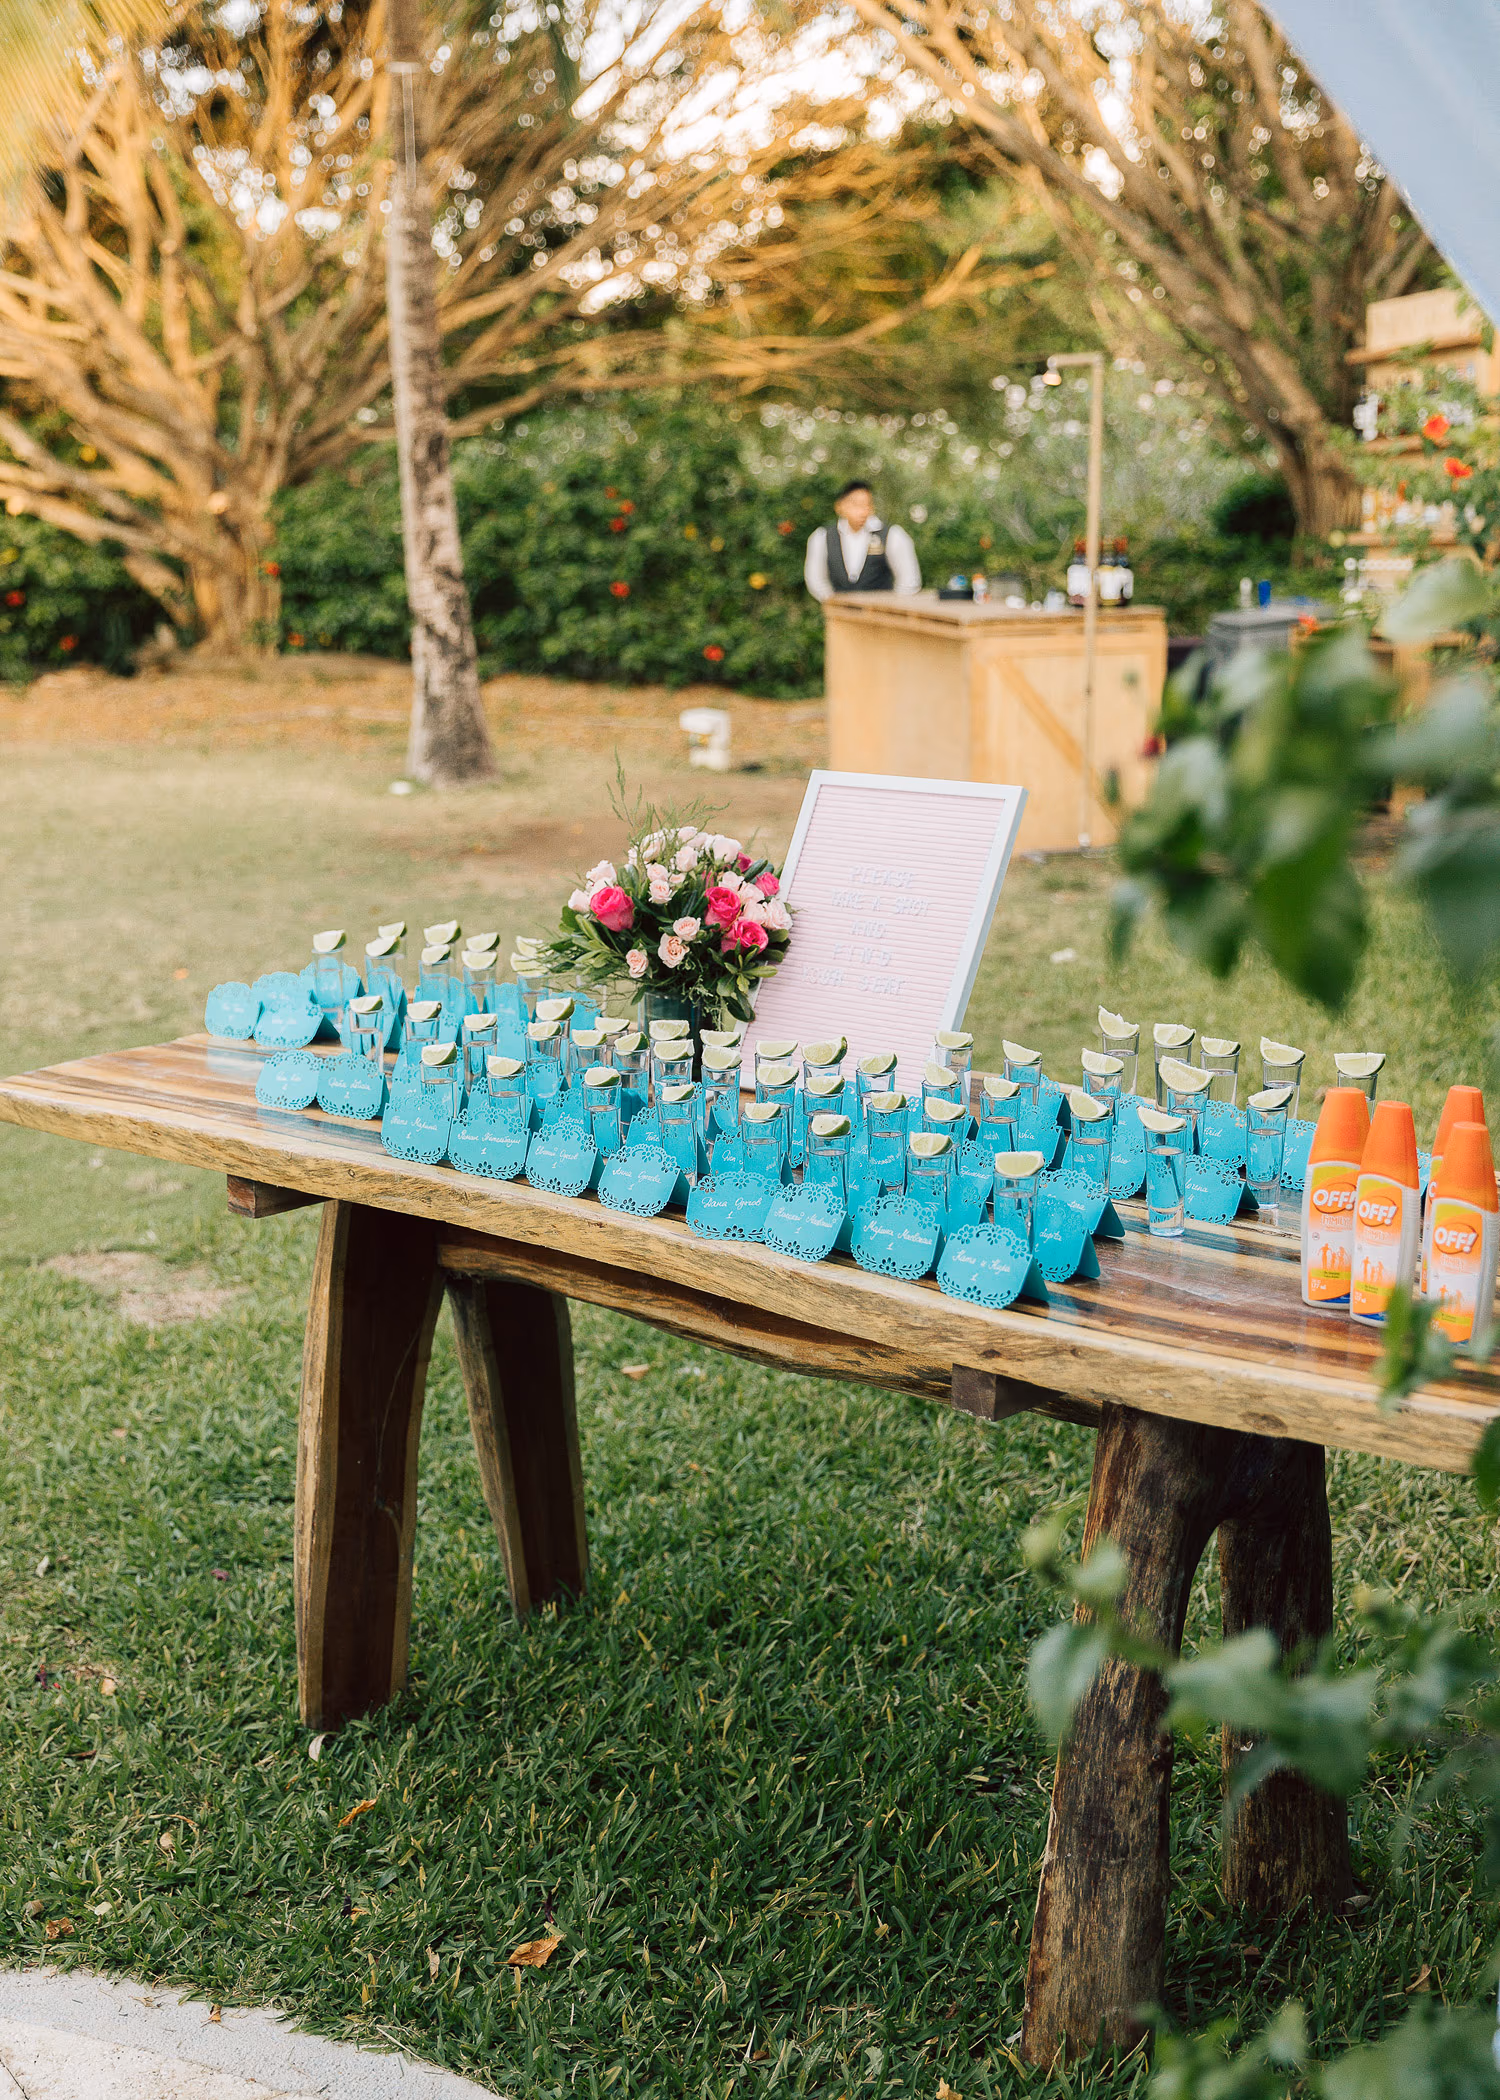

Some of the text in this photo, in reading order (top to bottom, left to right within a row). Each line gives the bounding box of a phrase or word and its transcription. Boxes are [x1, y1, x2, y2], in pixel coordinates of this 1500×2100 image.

[850, 866, 914, 889] PLEASE
[831, 889, 864, 909] TAKE
[850, 920, 888, 939] AND
[832, 943, 892, 967] FIND
[802, 965, 906, 995] YOUR SEAT
[1313, 1189, 1356, 1210] OFF!
[1358, 1201, 1397, 1225] OFF!
[1434, 1227, 1477, 1253] OFF!
